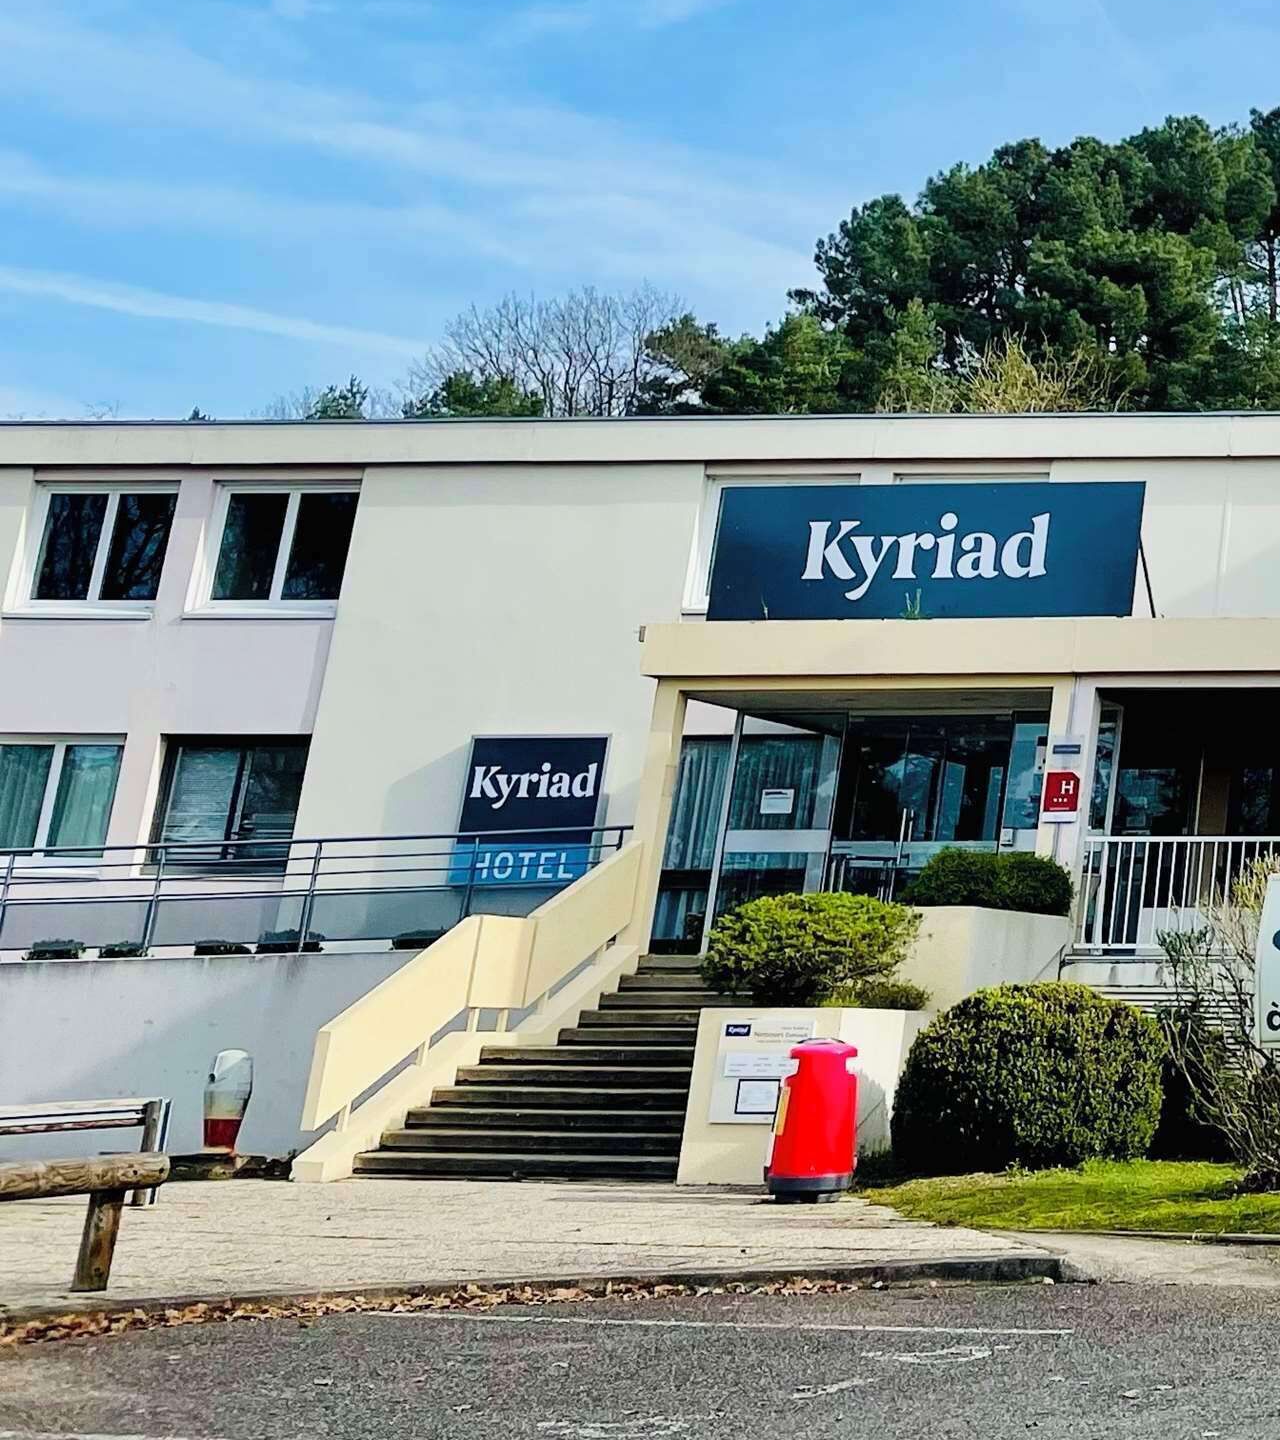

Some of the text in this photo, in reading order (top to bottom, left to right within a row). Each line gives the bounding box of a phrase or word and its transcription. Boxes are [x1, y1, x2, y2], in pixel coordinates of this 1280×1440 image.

[801, 511, 1051, 602] Kyriad
[469, 762, 598, 810] Kyriad
[1060, 780, 1075, 795] H
[473, 851, 574, 880] HOTEL
